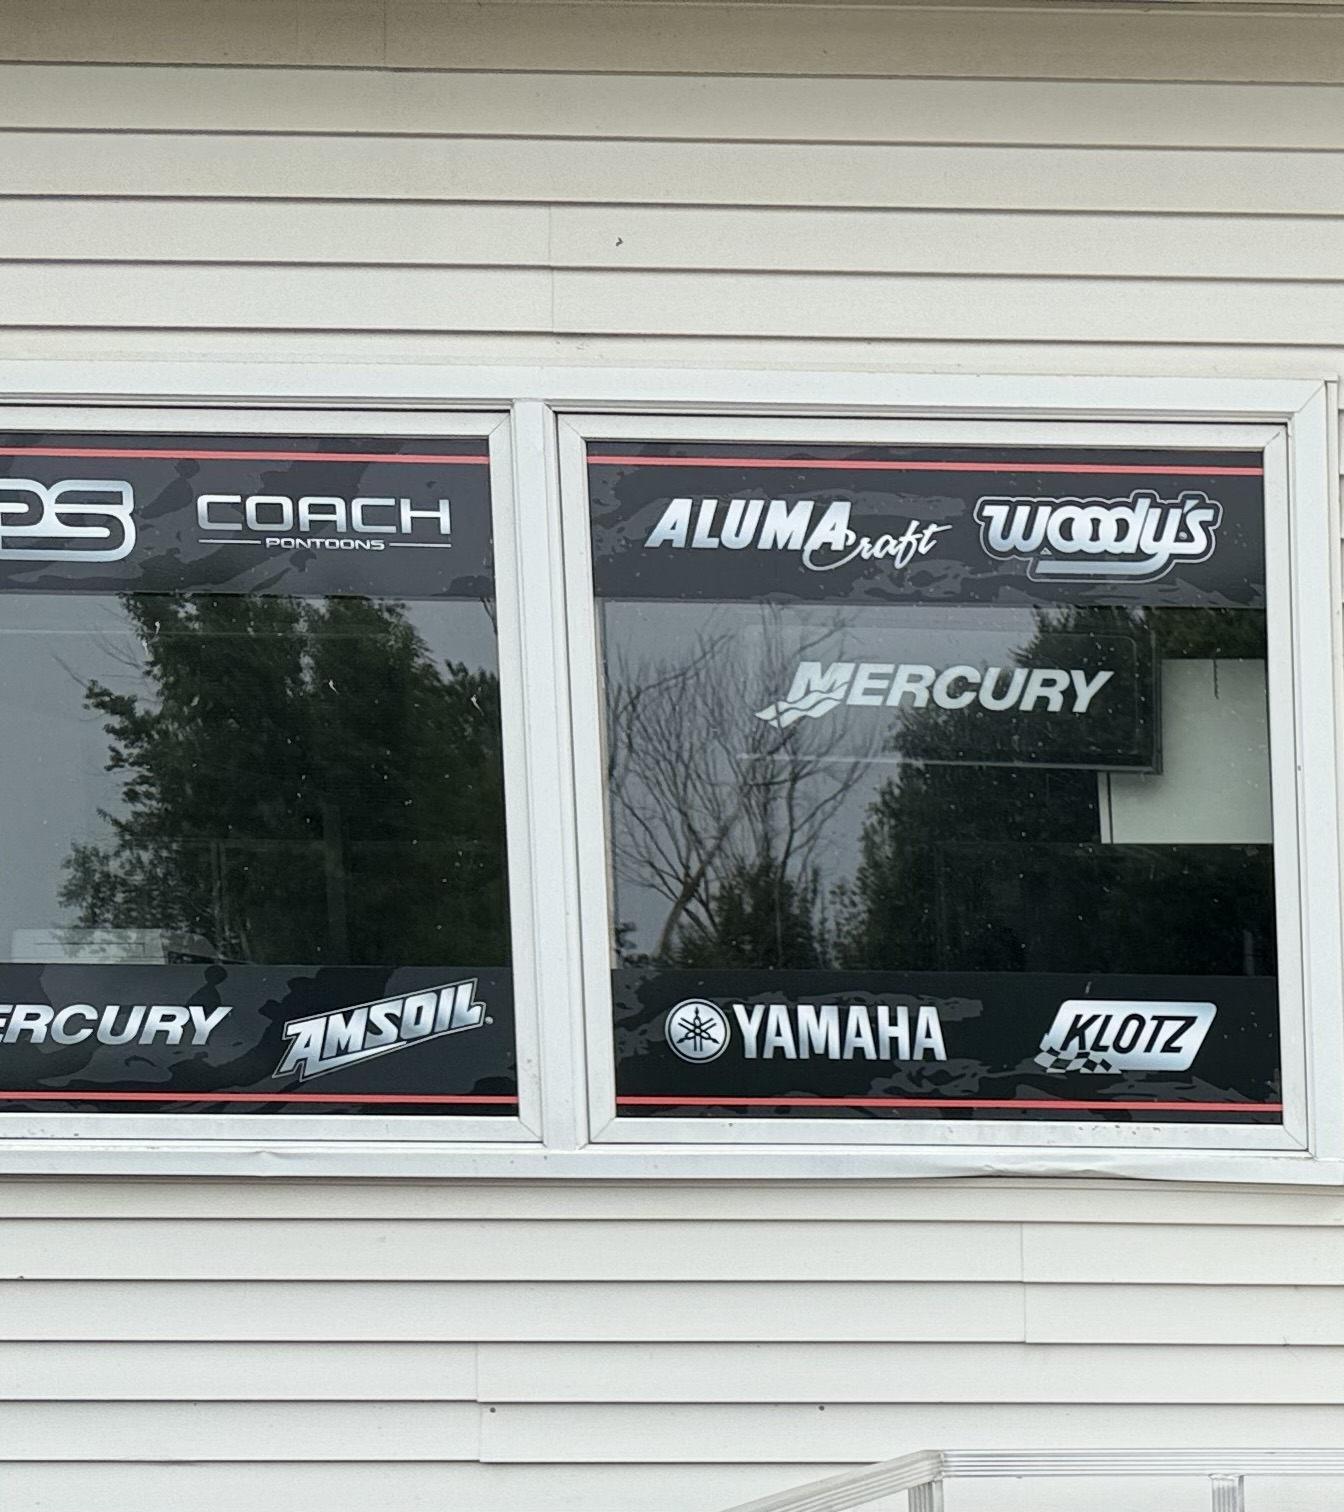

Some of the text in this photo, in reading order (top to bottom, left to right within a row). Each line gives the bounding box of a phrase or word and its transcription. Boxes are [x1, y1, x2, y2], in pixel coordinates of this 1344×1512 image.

[197, 495, 451, 534] COACH
[265, 538, 385, 550] PONTOONS
[756, 661, 1116, 726] MERCURY
[0, 1004, 233, 1045] RCURY
[277, 980, 487, 1078] AMSOIL
[733, 1004, 947, 1060] YAMAHA
[1060, 1013, 1198, 1055] KLOTZ
